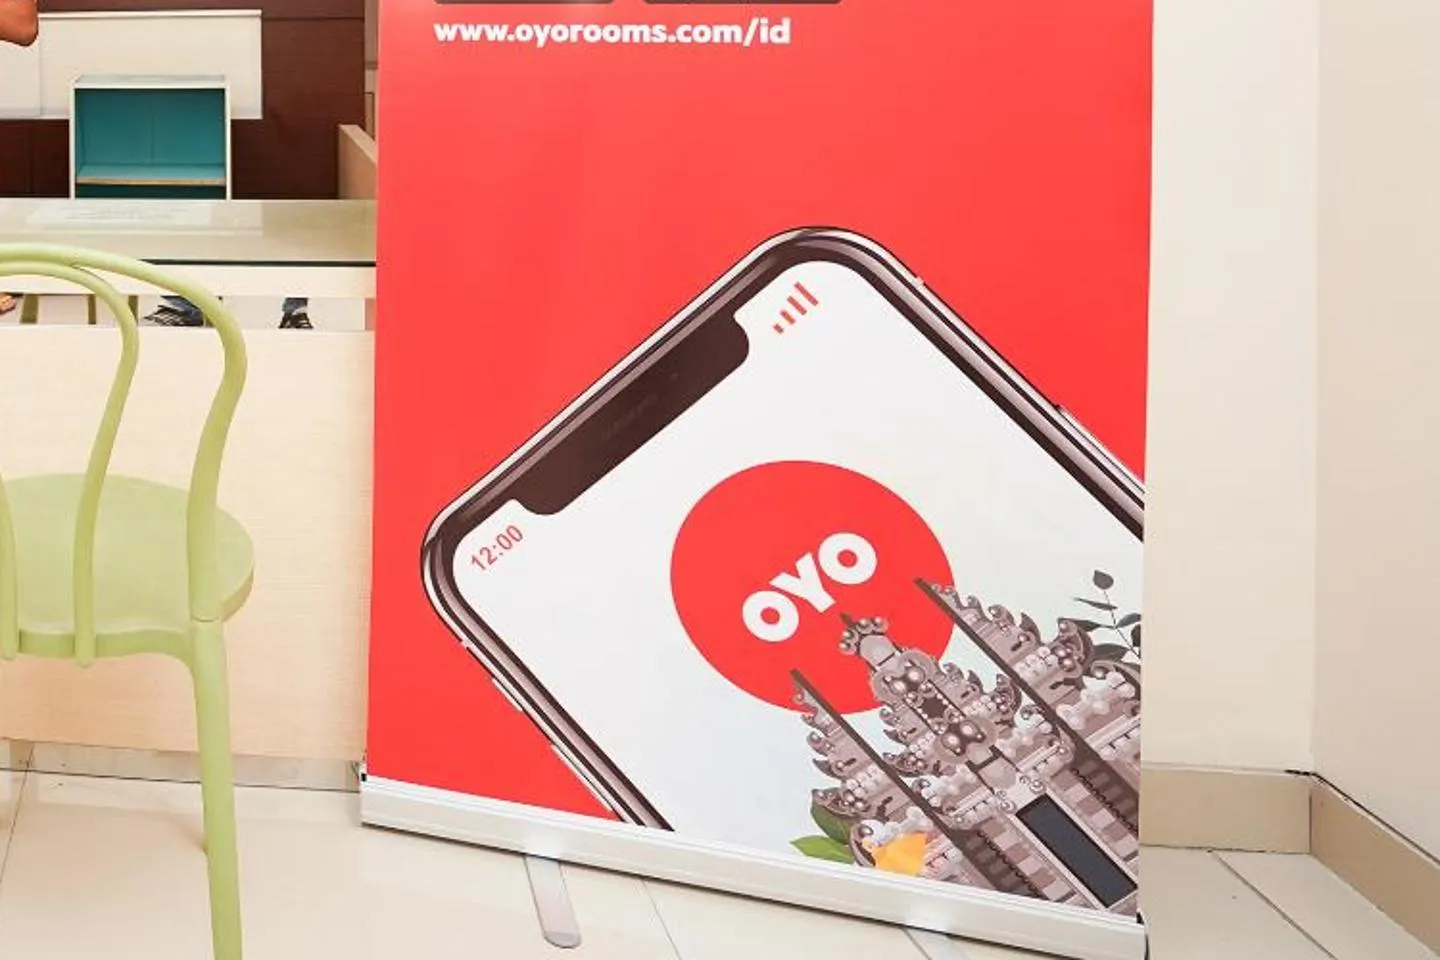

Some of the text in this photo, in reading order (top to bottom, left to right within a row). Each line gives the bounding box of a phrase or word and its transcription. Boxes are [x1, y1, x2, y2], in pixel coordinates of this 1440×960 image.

[433, 17, 792, 49] www.oyorooms.com/id
[471, 525, 523, 571] 12:00
[742, 532, 878, 642] OYO
